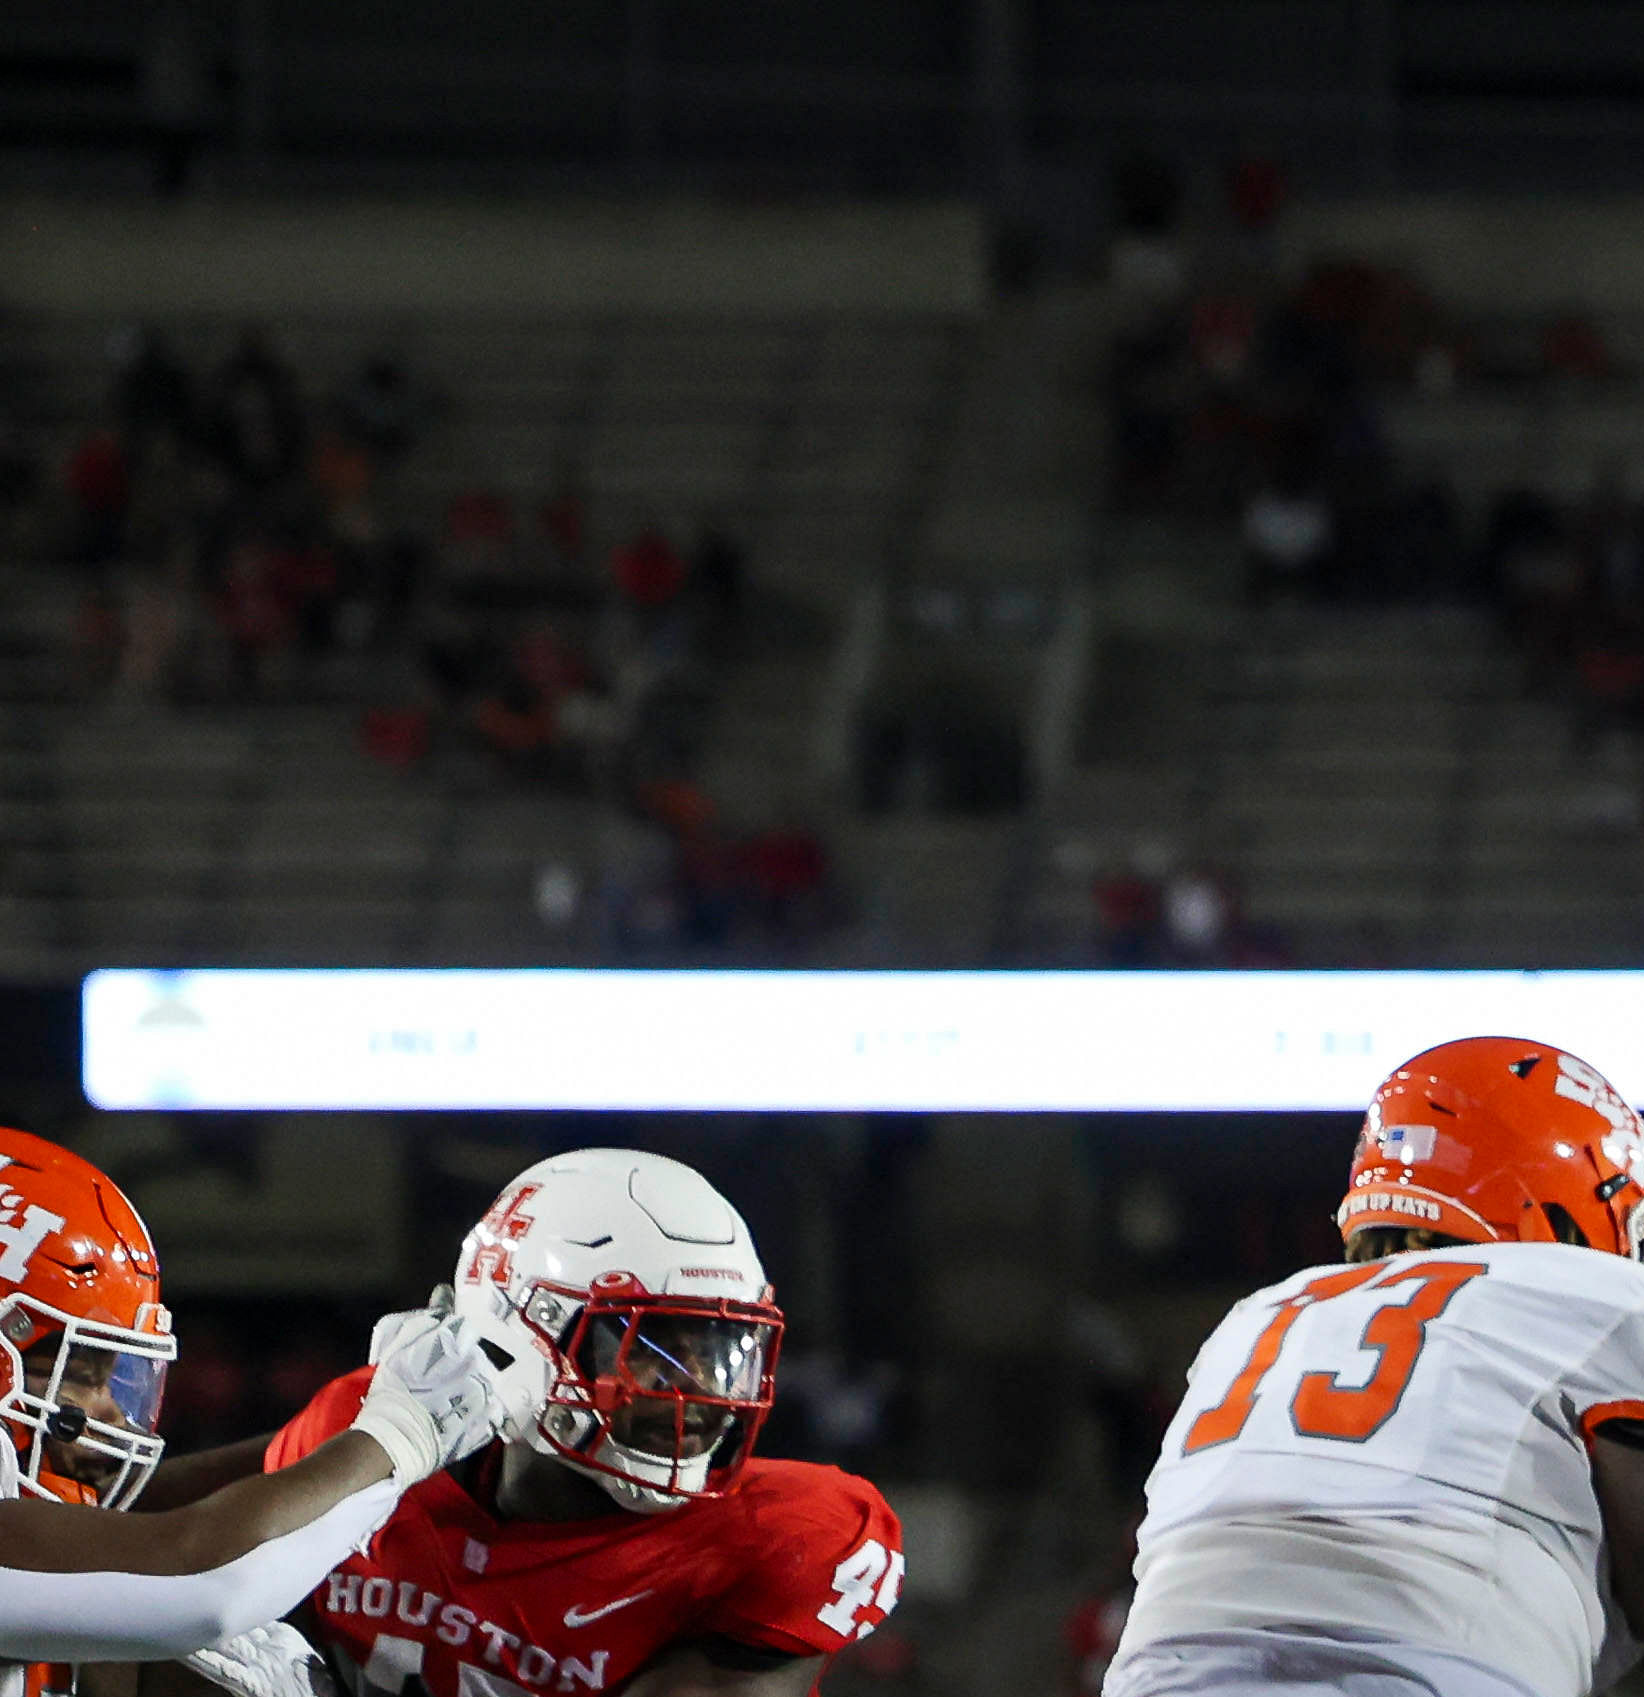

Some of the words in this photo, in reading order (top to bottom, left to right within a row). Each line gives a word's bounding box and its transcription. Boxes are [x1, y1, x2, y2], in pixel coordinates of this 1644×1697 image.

[680, 1266, 746, 1282] HOUSTON
[1180, 1260, 1489, 1459] 73
[325, 1571, 610, 1693] HOUSTON
